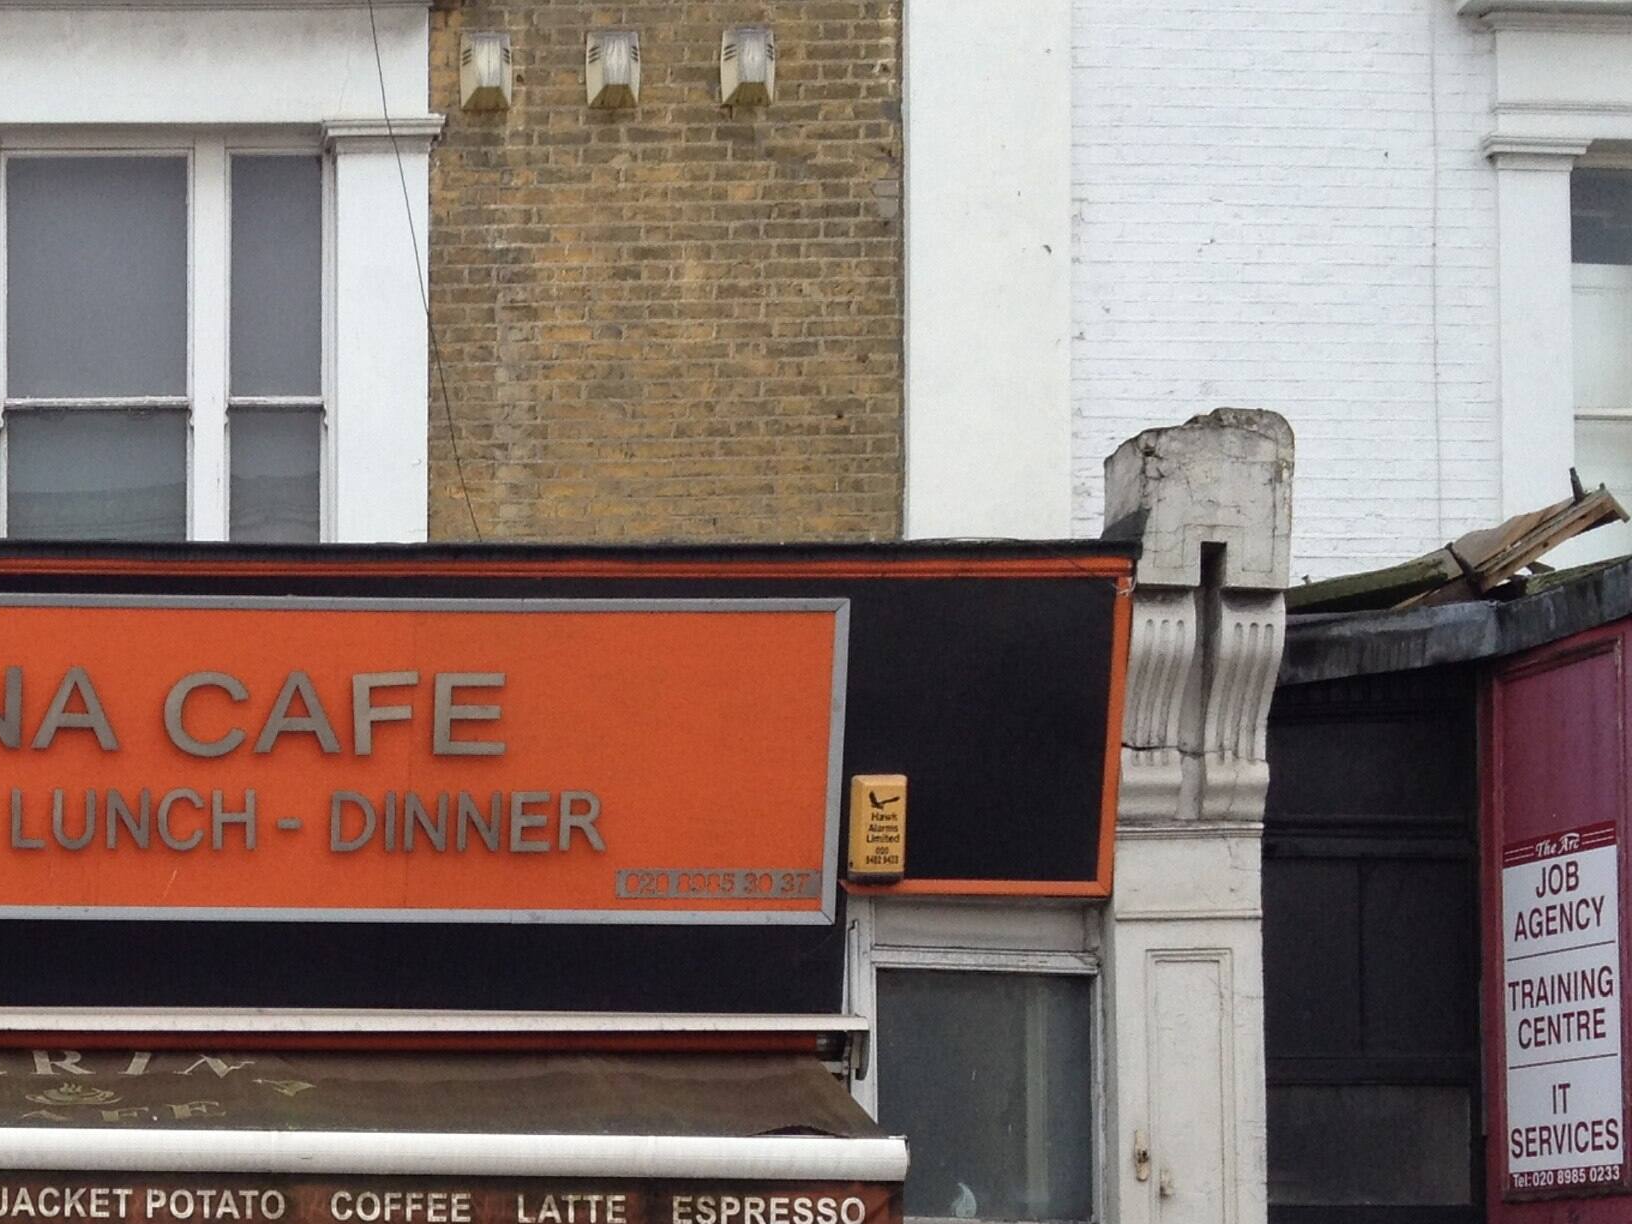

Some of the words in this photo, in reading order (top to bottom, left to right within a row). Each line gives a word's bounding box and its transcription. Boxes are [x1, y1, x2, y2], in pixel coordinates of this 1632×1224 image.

[164, 669, 507, 757] CAFE
[9, 786, 256, 852] LUNCH
[329, 790, 606, 853] DINNER
[866, 833, 900, 843] Limited
[1535, 839, 1557, 857] The
[1536, 860, 1580, 898] JOB
[1514, 895, 1605, 942] AGENCY
[1508, 965, 1614, 1011] TRAINING
[1518, 1007, 1606, 1050] CENTRE
[1552, 1083, 1571, 1115] IT
[1511, 1117, 1620, 1159] SERVICES
[1557, 1168, 1586, 1185] 8985
[1589, 1165, 1620, 1182] 0233
[145, 1188, 286, 1220] POTATO
[330, 1190, 471, 1224] COFFEE
[517, 1194, 627, 1224] LATTE
